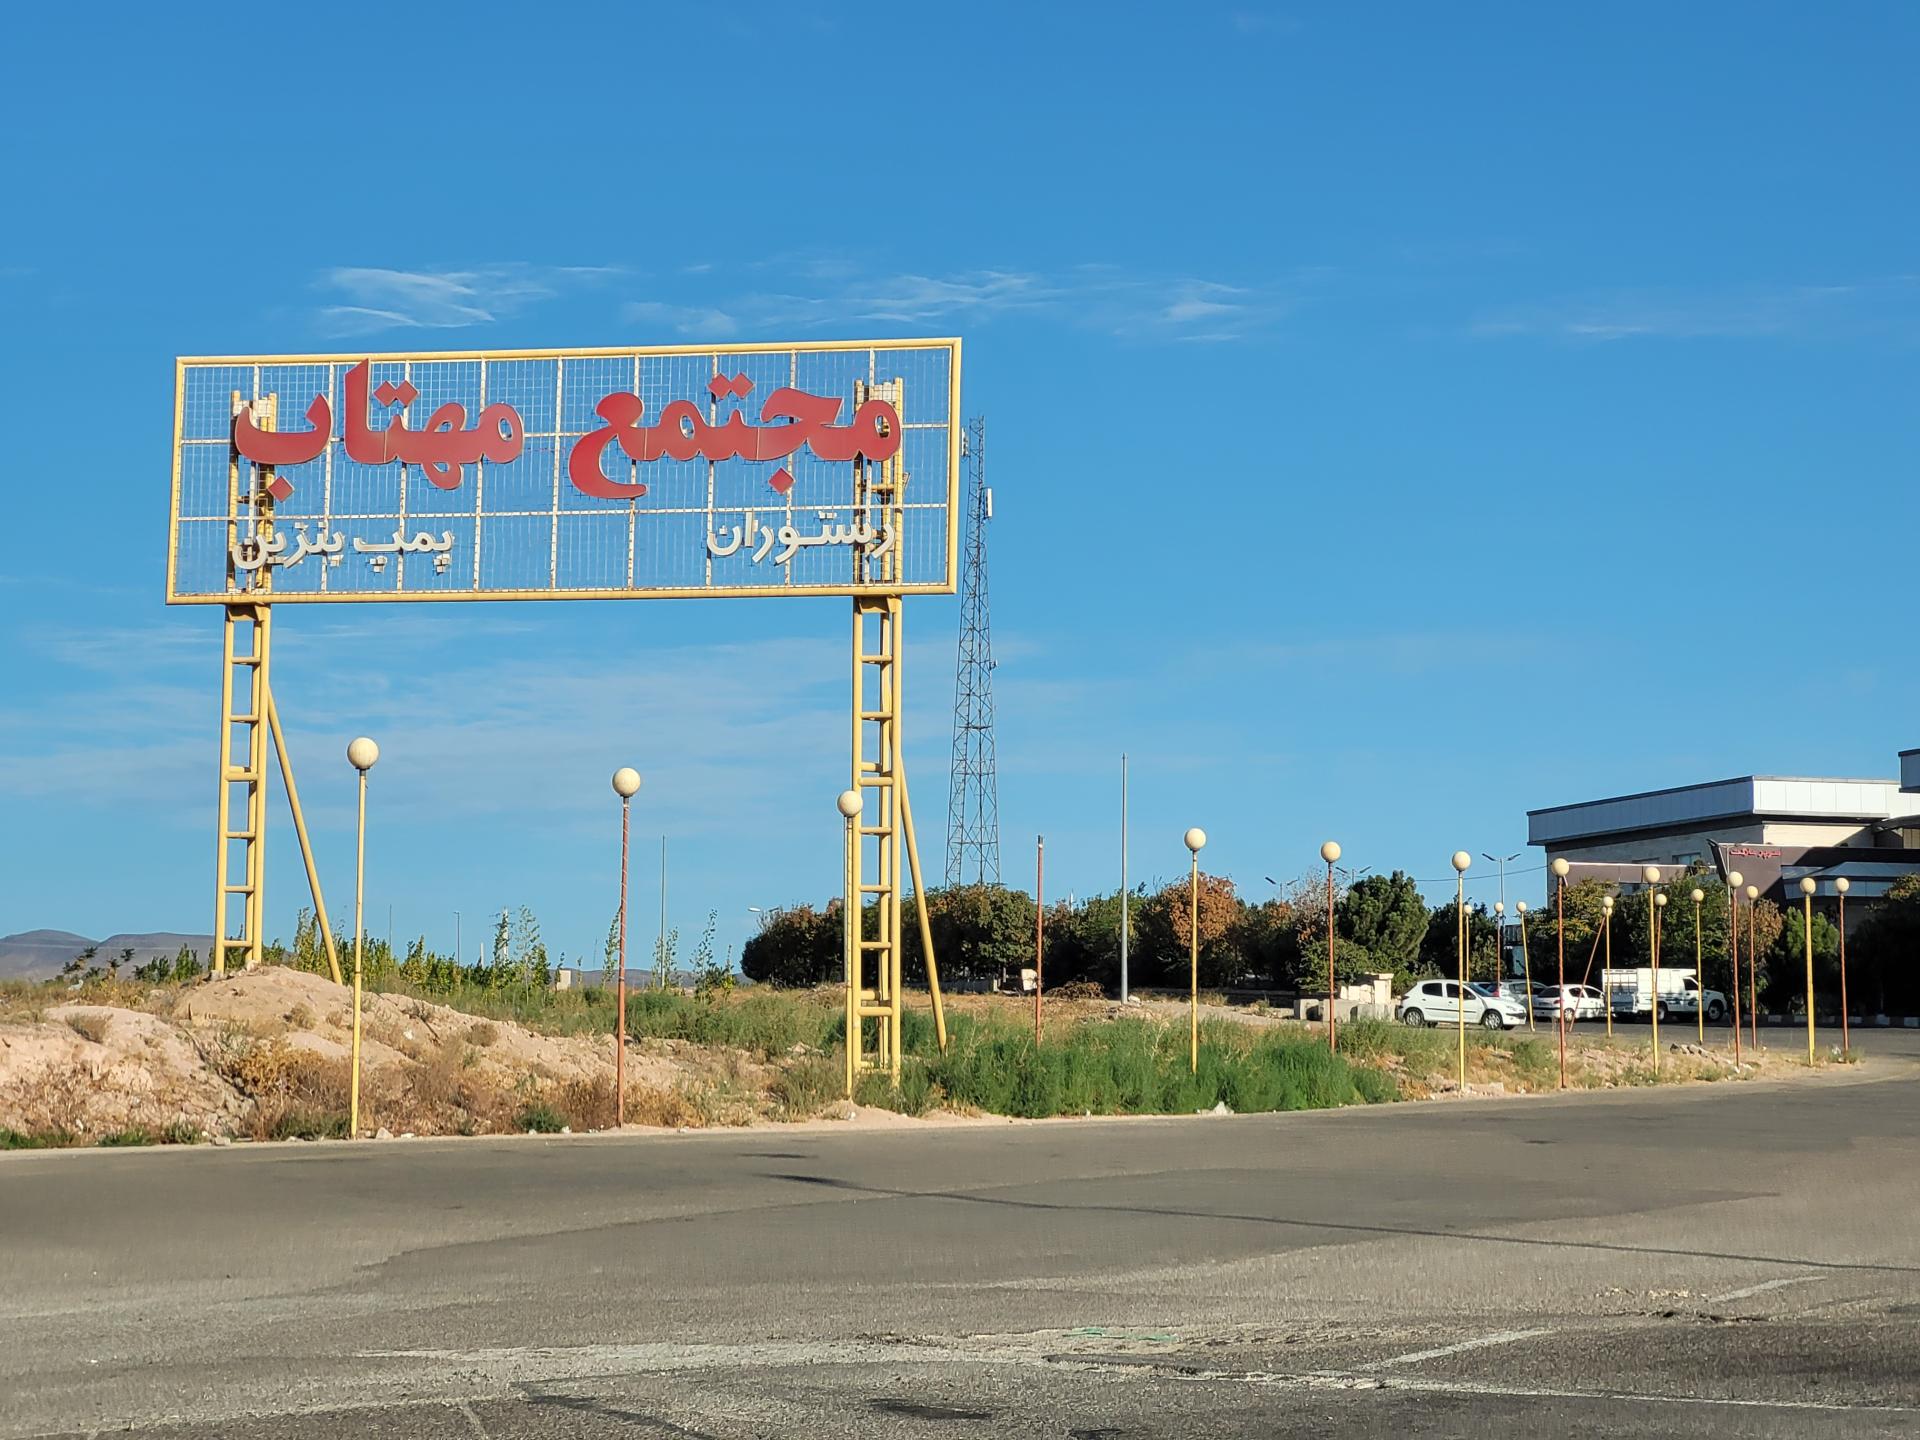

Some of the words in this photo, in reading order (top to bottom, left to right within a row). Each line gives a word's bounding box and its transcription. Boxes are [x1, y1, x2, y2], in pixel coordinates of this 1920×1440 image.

[234, 358, 524, 502] مهتاب
[568, 372, 901, 500] مجتمع
[231, 521, 346, 570] بنزین
[353, 527, 455, 575] پمپ
[707, 511, 896, 565] رستوران
